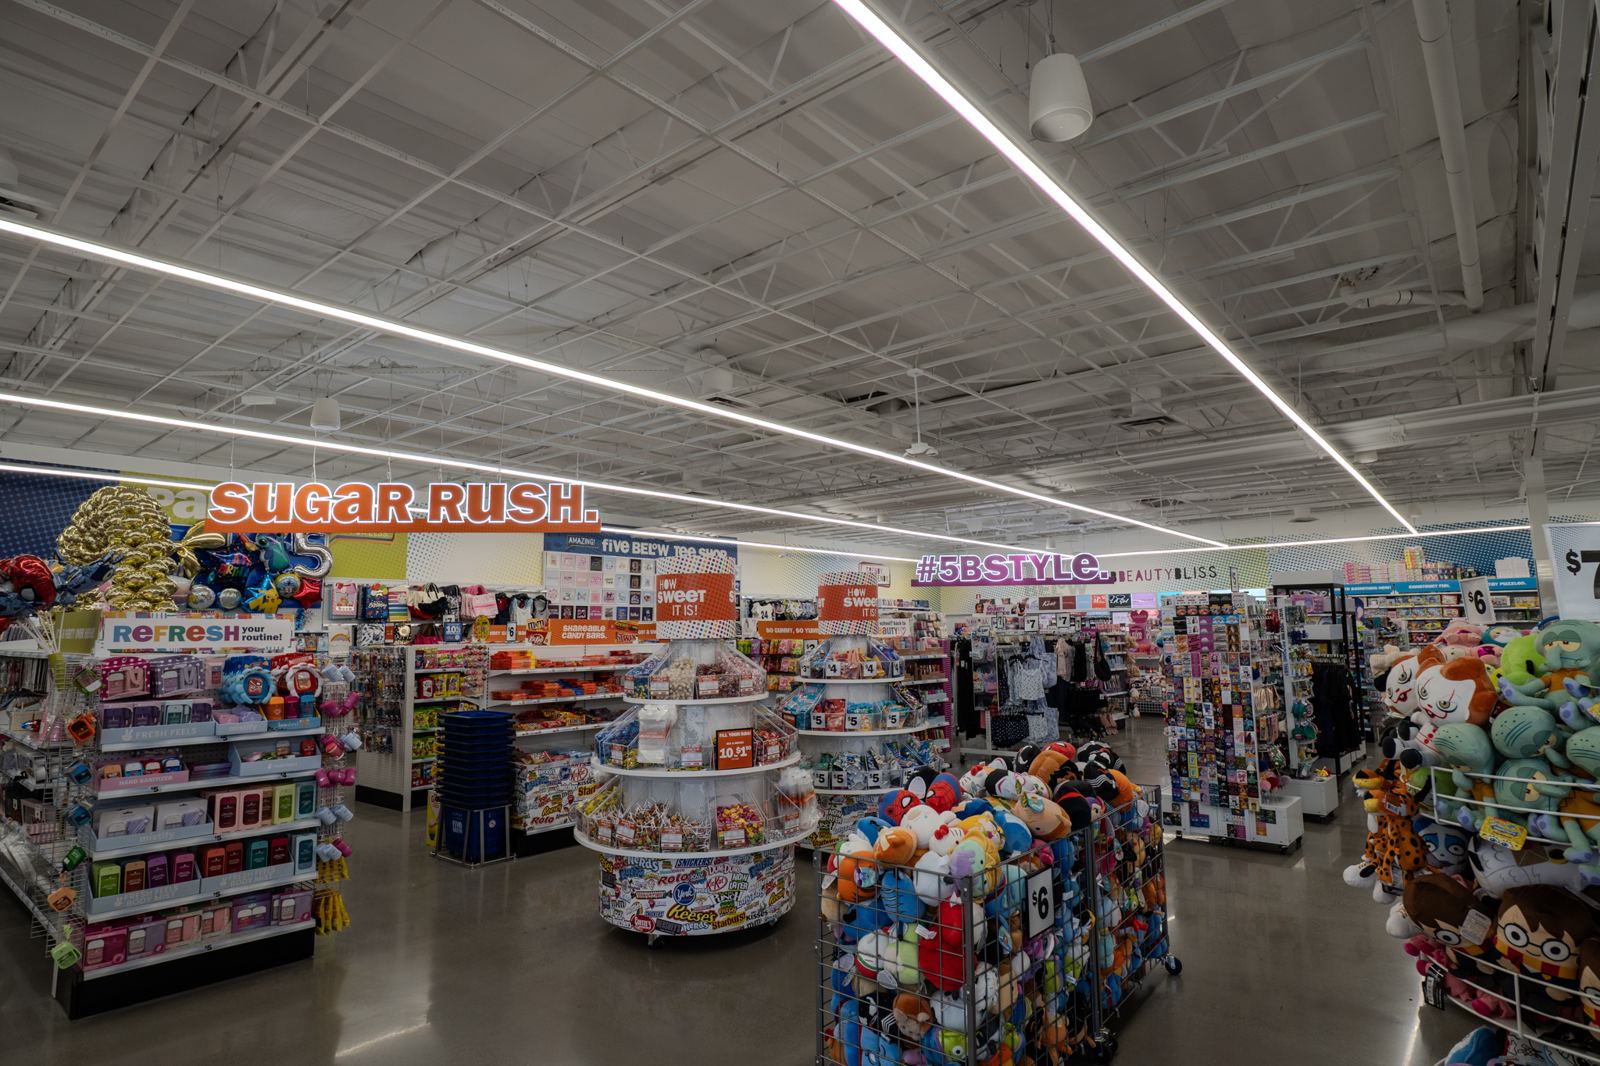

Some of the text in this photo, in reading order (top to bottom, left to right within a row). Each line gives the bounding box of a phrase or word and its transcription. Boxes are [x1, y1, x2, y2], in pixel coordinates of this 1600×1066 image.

[568, 536, 596, 546] AMAZING!
[660, 578, 677, 590] HOW
[847, 588, 867, 597] HOW
[1467, 590, 1487, 615] $6
[672, 604, 698, 616] IT IS!
[862, 608, 869, 617] IT
[1027, 619, 1036, 629] $7
[1059, 617, 1068, 625] $7
[241, 626, 265, 634] your
[241, 633, 283, 642] routine!
[828, 664, 837, 673] $4
[865, 664, 874, 673] $4
[812, 715, 823, 725] $5
[847, 716, 858, 726] $5
[888, 714, 897, 724] $5
[816, 773, 825, 783] $5
[833, 774, 844, 783] $5
[869, 773, 880, 783] $5
[1032, 886, 1049, 919] $6
